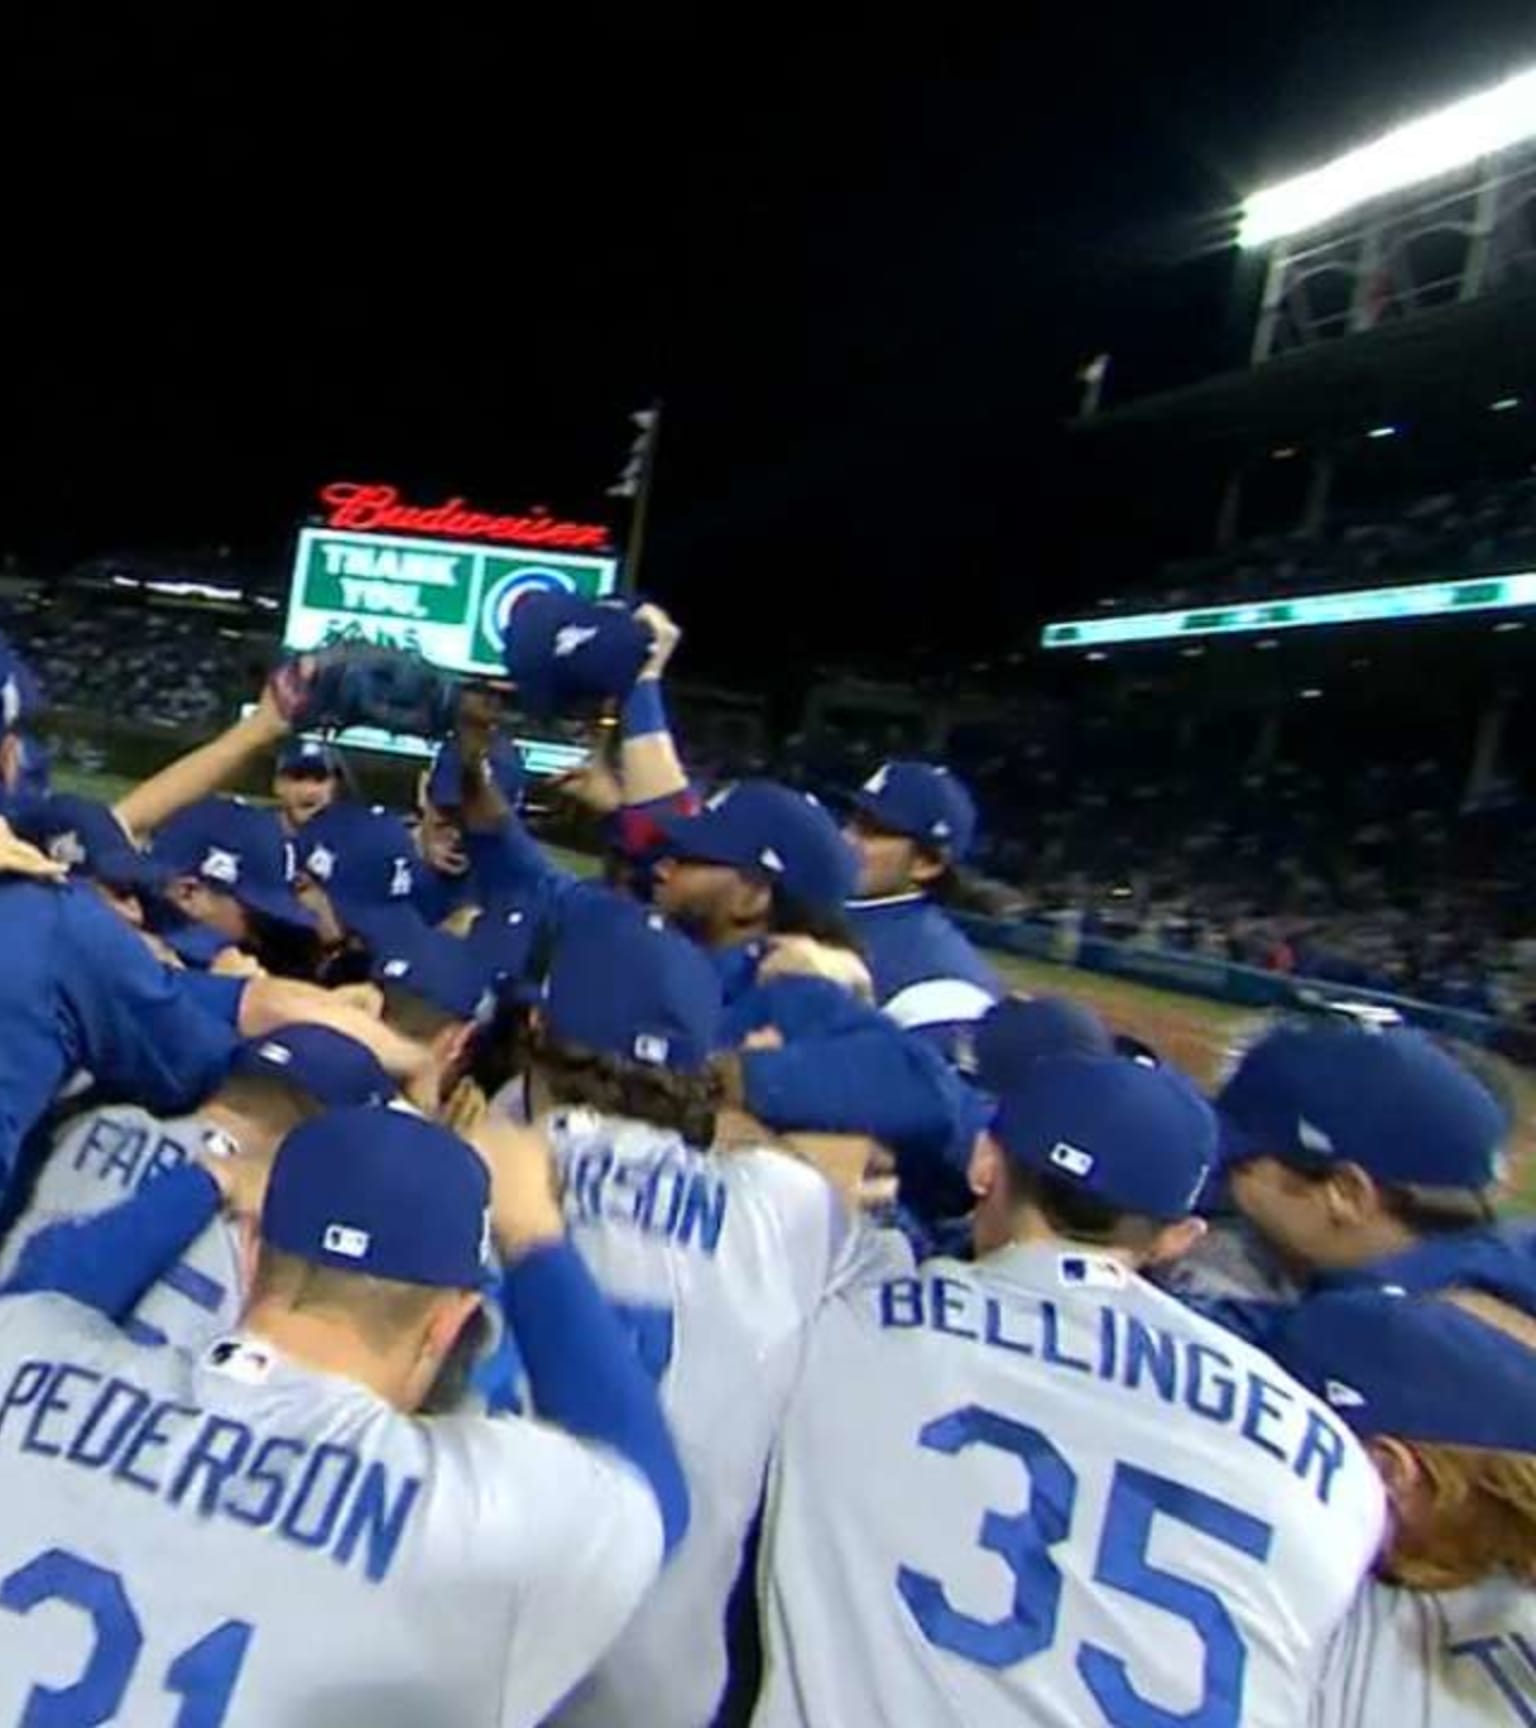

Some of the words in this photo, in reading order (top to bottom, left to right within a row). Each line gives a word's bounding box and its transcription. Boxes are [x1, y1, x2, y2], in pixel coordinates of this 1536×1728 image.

[320, 543, 462, 587] THANK
[321, 483, 609, 547] Budweiser
[878, 1277, 1348, 1504] BELLINGER
[896, 1404, 1276, 1728] 35
